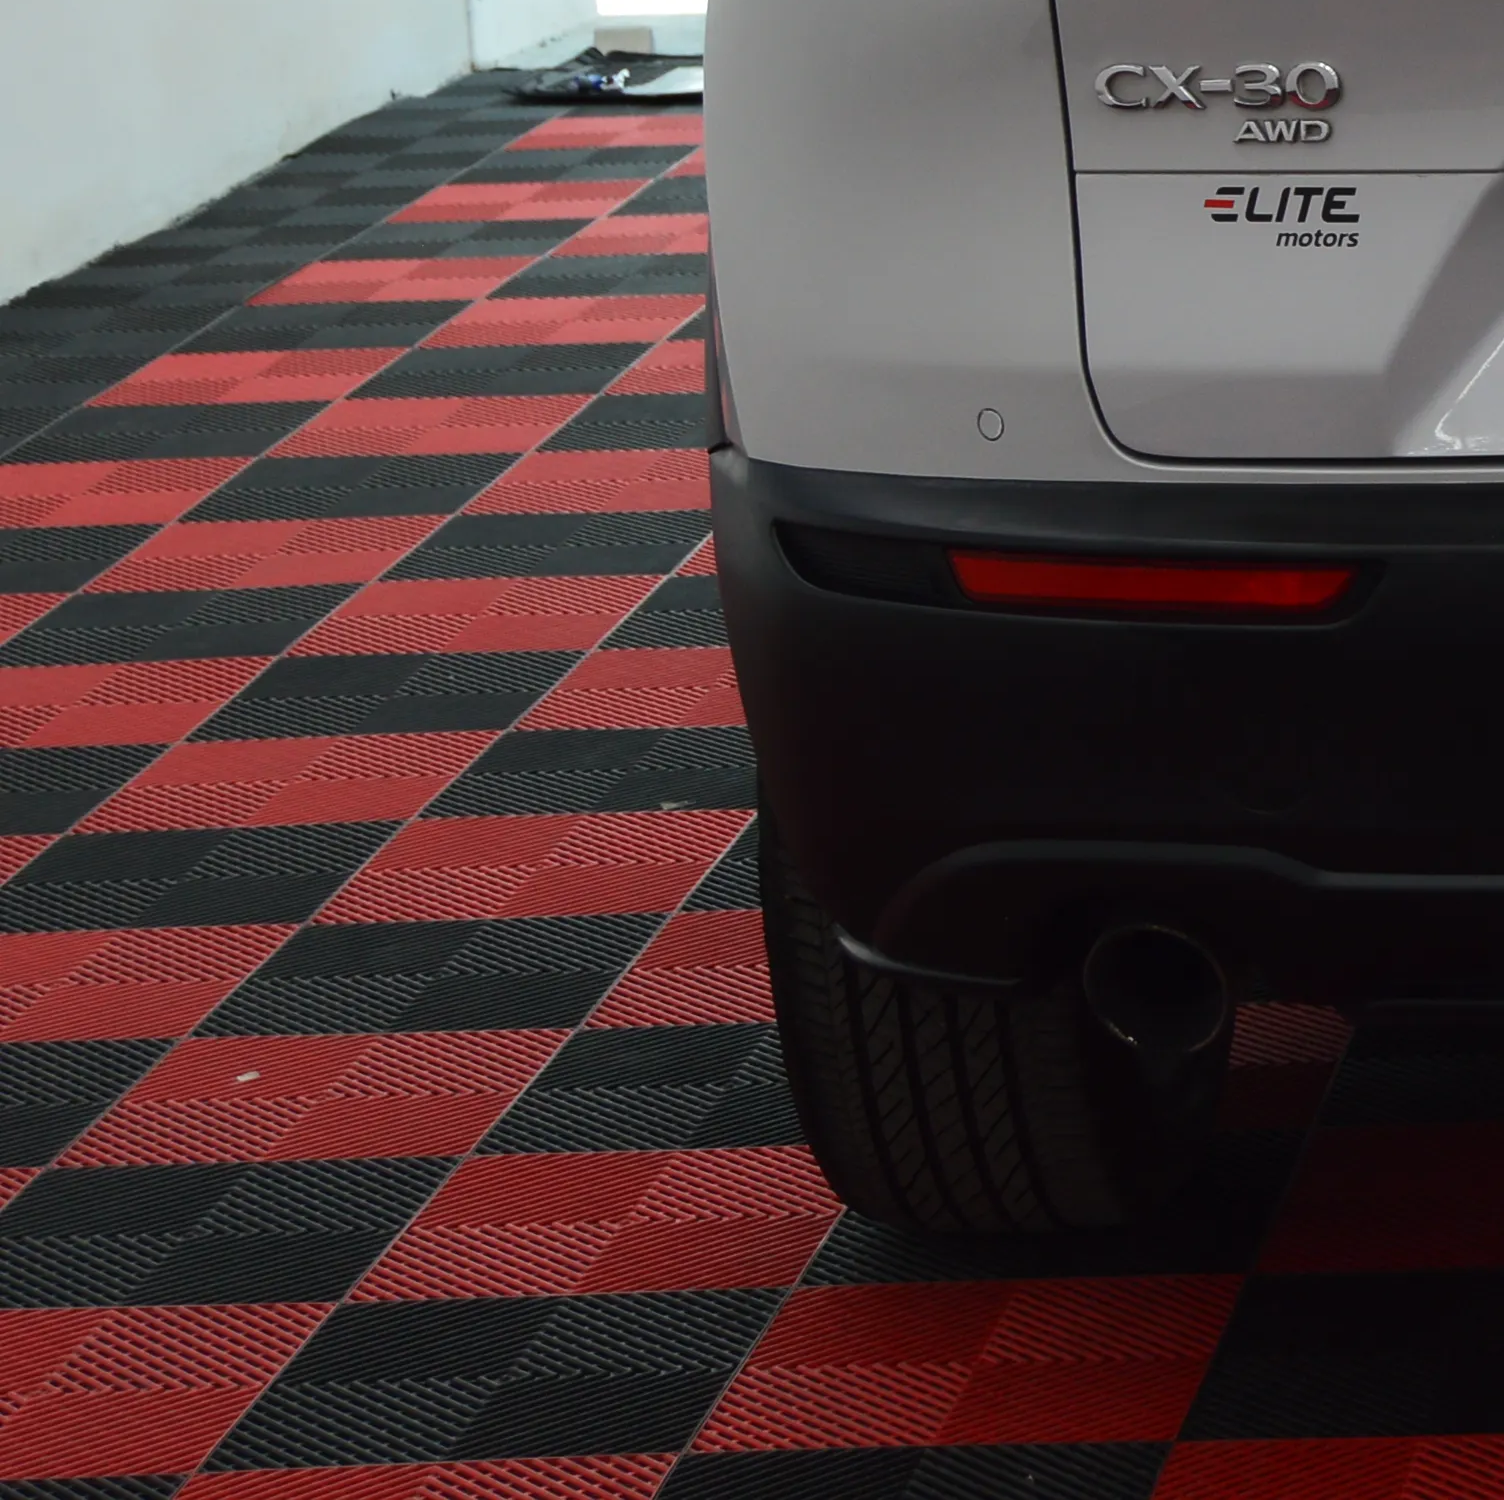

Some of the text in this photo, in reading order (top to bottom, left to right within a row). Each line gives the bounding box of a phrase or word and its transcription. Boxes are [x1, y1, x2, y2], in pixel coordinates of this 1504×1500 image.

[1094, 60, 1344, 110] CX-30
[1232, 119, 1331, 144] AWD
[1203, 186, 1361, 224] ELITE
[1275, 228, 1360, 248] motors
